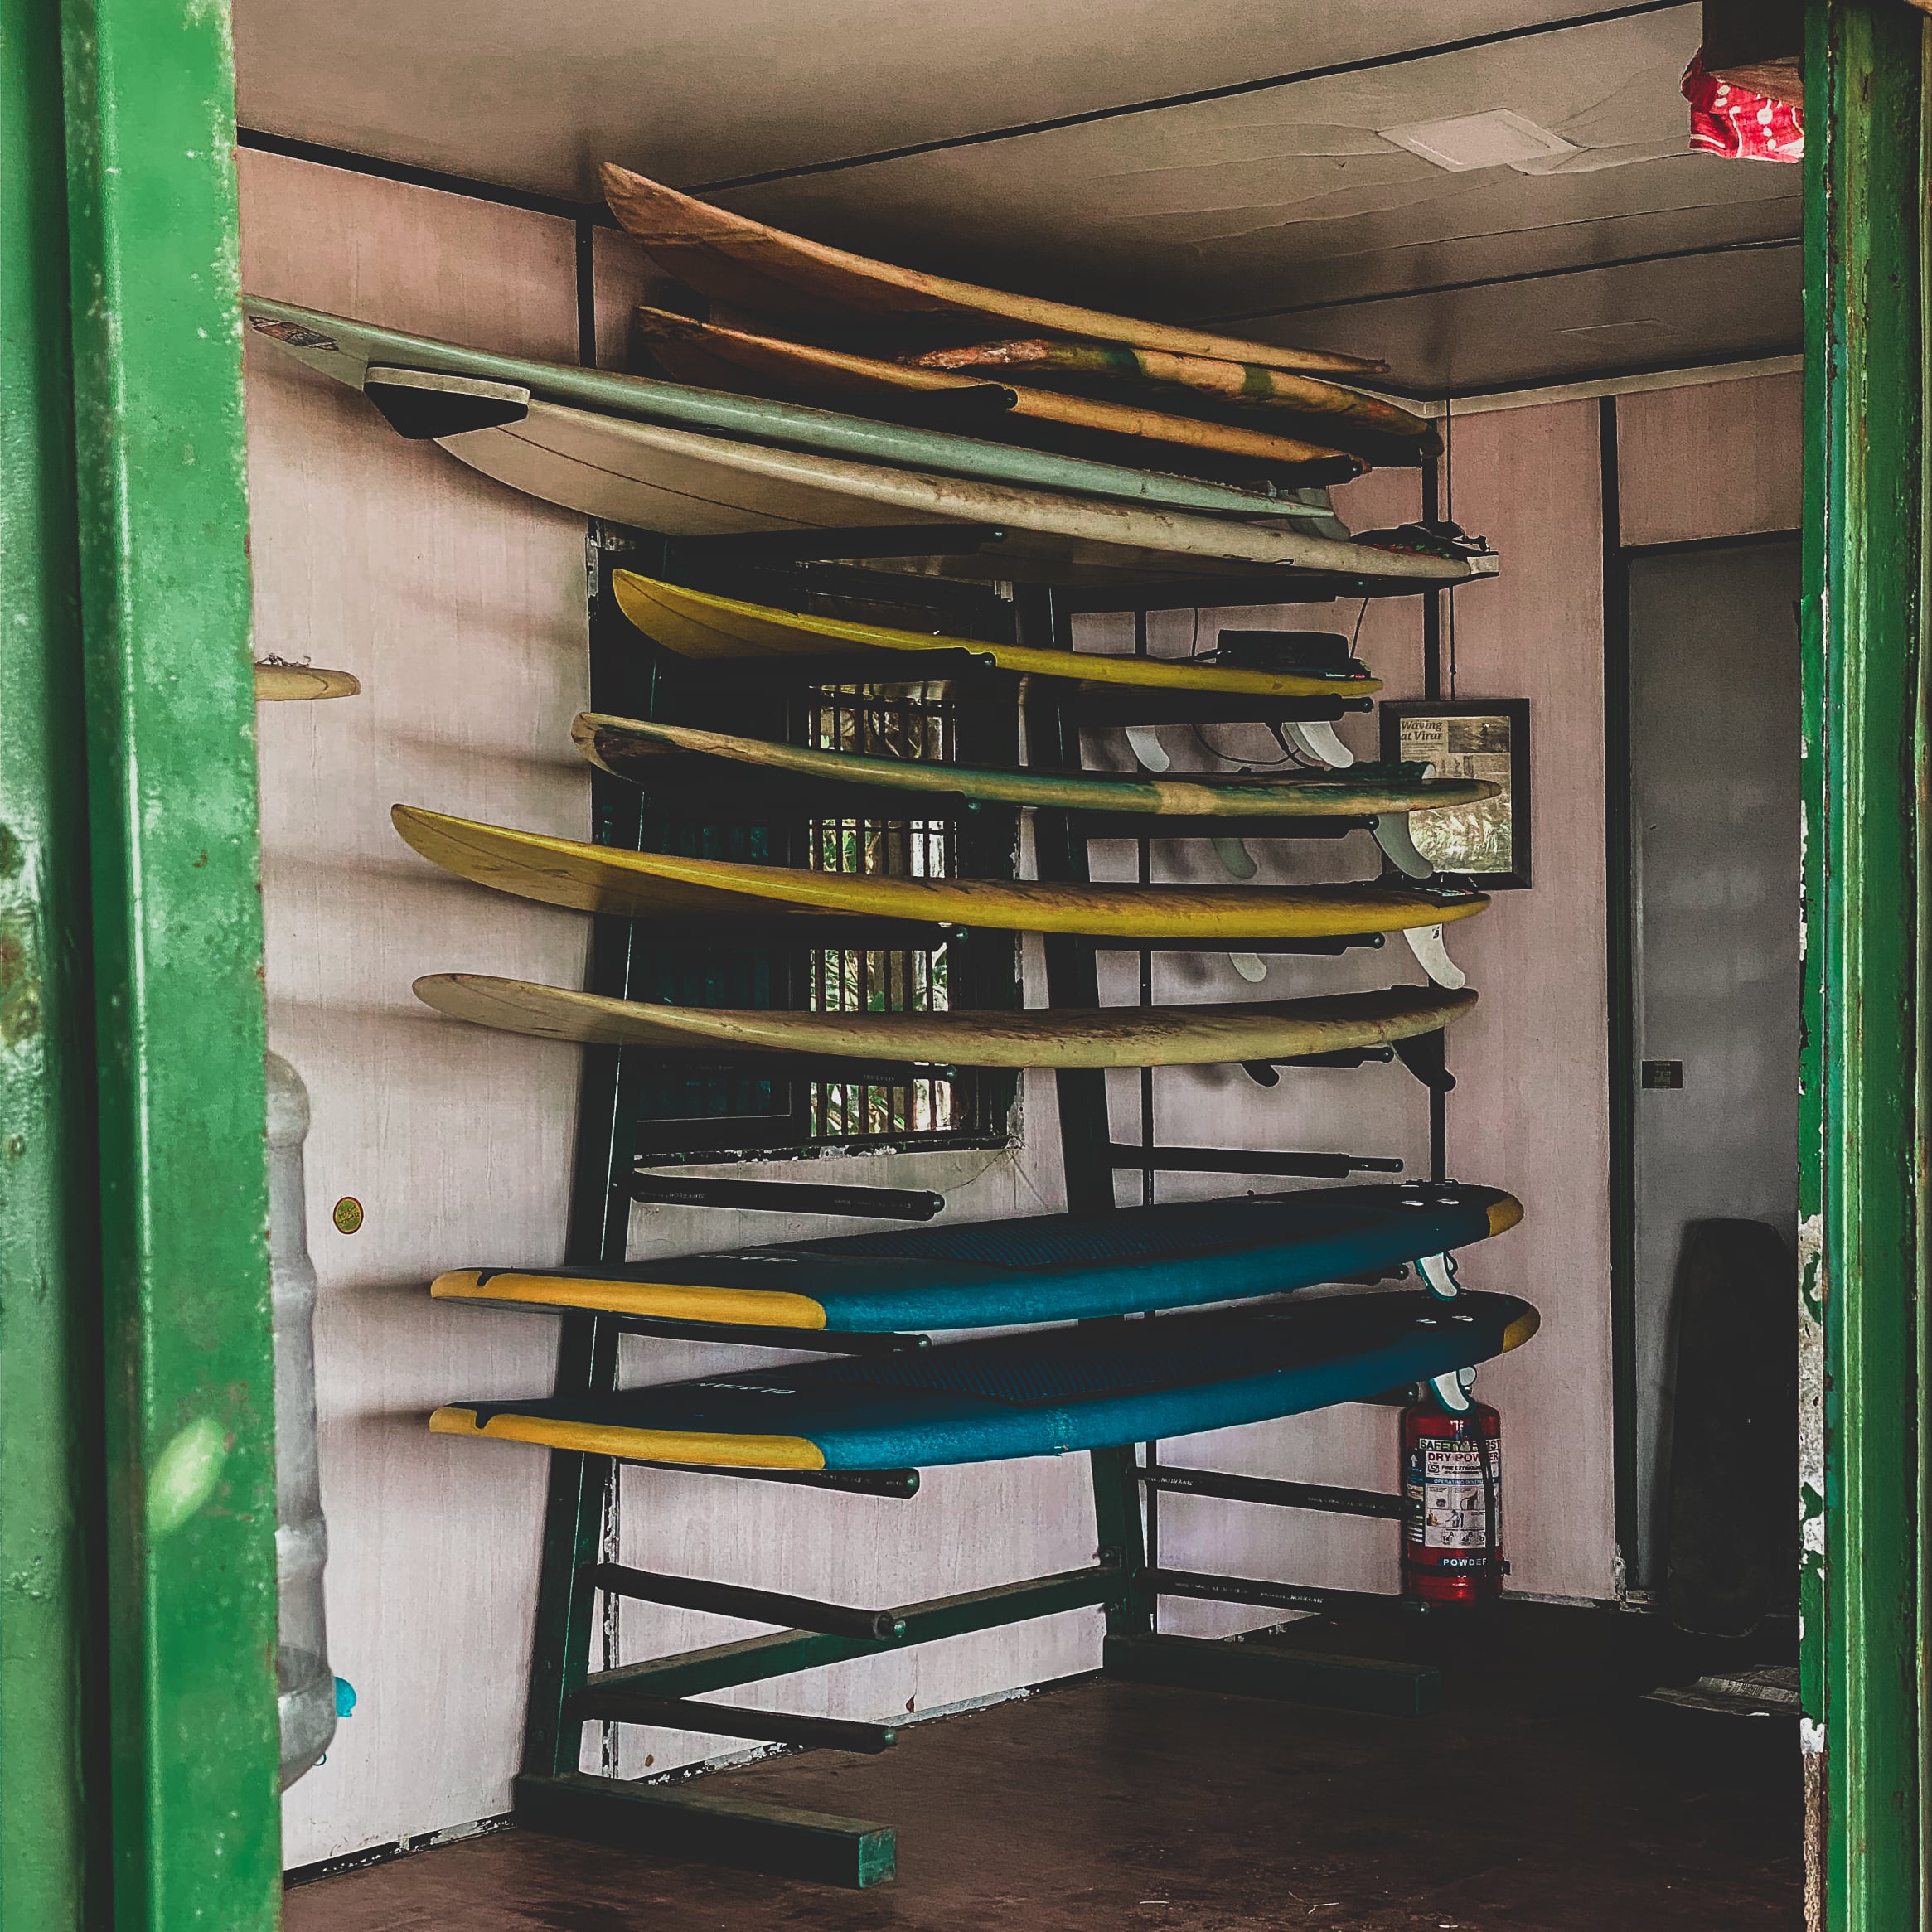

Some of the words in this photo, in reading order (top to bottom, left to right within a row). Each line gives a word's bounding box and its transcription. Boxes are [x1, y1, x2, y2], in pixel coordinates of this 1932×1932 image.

[1401, 720, 1443, 732] Waving
[1401, 732, 1411, 741] at
[1414, 731, 1443, 741] Virar
[1428, 1452, 1451, 1461] DRY
[1455, 1452, 1499, 1462] POWER
